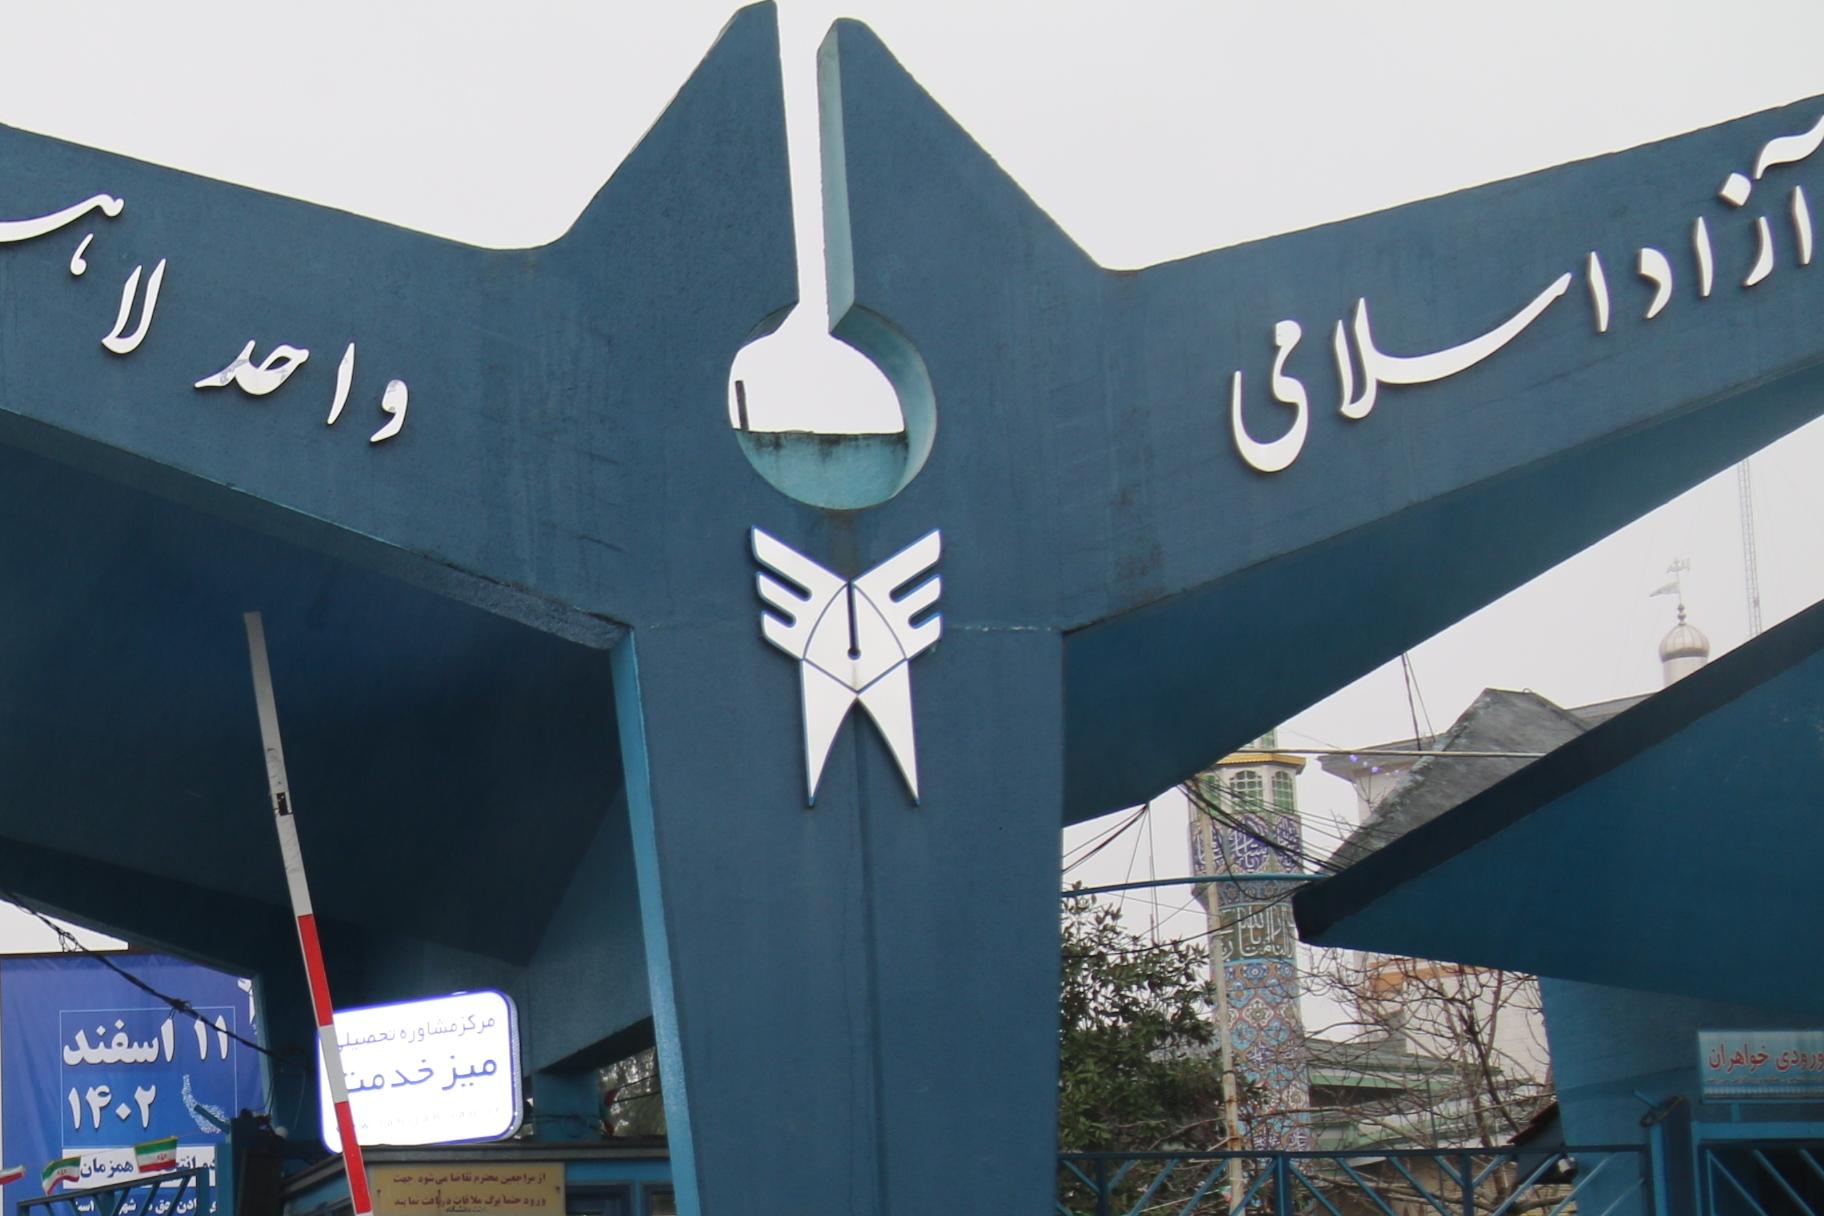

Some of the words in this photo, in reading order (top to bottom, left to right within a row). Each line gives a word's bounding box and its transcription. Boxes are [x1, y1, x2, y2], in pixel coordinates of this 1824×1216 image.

[1231, 251, 1610, 472] اسلامی
[194, 339, 409, 444] واحد
[62, 1017, 176, 1067] اسفند
[194, 1014, 229, 1061] ۱۱
[400, 1018, 458, 1043] مشاوره
[458, 1014, 496, 1037] مرکز
[344, 1058, 434, 1094] خدمت
[442, 1054, 498, 1091] میز
[1708, 1042, 1769, 1073] خواهران
[68, 1083, 157, 1130] ۱۴۰۲
[80, 1157, 134, 1178] همزمان
